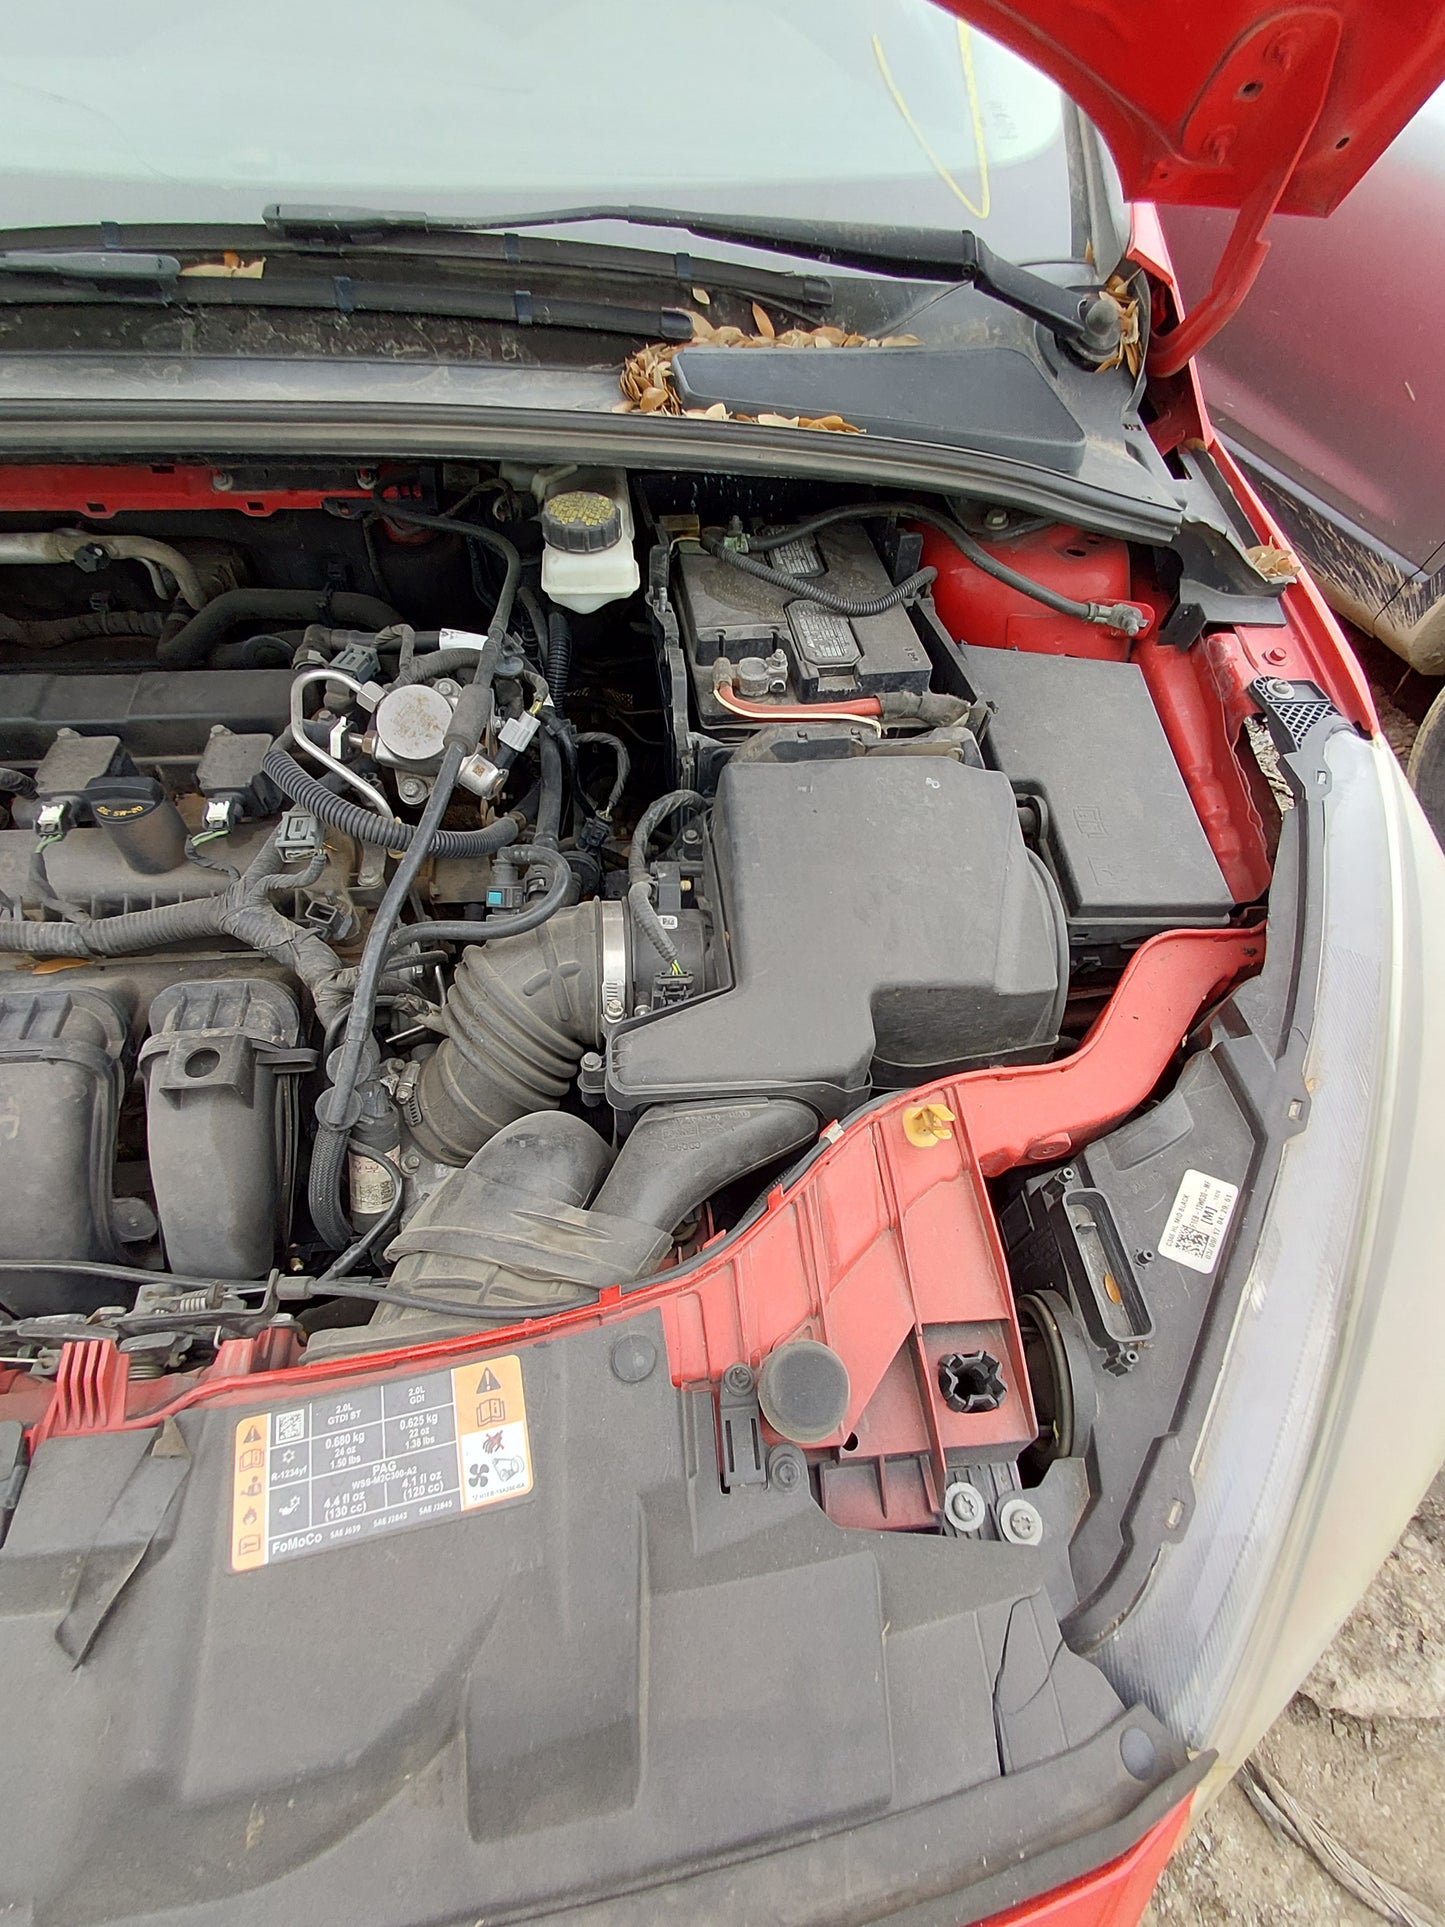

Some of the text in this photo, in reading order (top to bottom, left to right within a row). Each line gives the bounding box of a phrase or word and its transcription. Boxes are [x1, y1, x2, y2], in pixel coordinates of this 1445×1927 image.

[1174, 1212, 1184, 1225] MID
[1179, 1194, 1190, 1213] BLACK
[1200, 1205, 1218, 1226] [M]
[408, 1386, 425, 1397] 2.0L
[409, 1394, 425, 1405] GDI
[335, 1403, 353, 1414] 2.0L
[327, 1410, 362, 1425] GTDI ST
[399, 1413, 438, 1431] 0.625 kg
[325, 1431, 365, 1449] 0.680 kg
[409, 1427, 430, 1440] 22 oz
[405, 1435, 435, 1450] 1.38 lbs
[334, 1447, 357, 1458] 24 oz
[330, 1454, 361, 1470] 1.50 lbs
[372, 1461, 397, 1476] PAG
[271, 1465, 307, 1481] R-1234yf
[402, 1471, 442, 1489] 4.1 fl oz
[403, 1480, 444, 1501] (120 cc)
[324, 1491, 366, 1509] 4.4 fl oz
[325, 1501, 367, 1522] (130 cc)
[272, 1533, 323, 1555] FoMoCo
